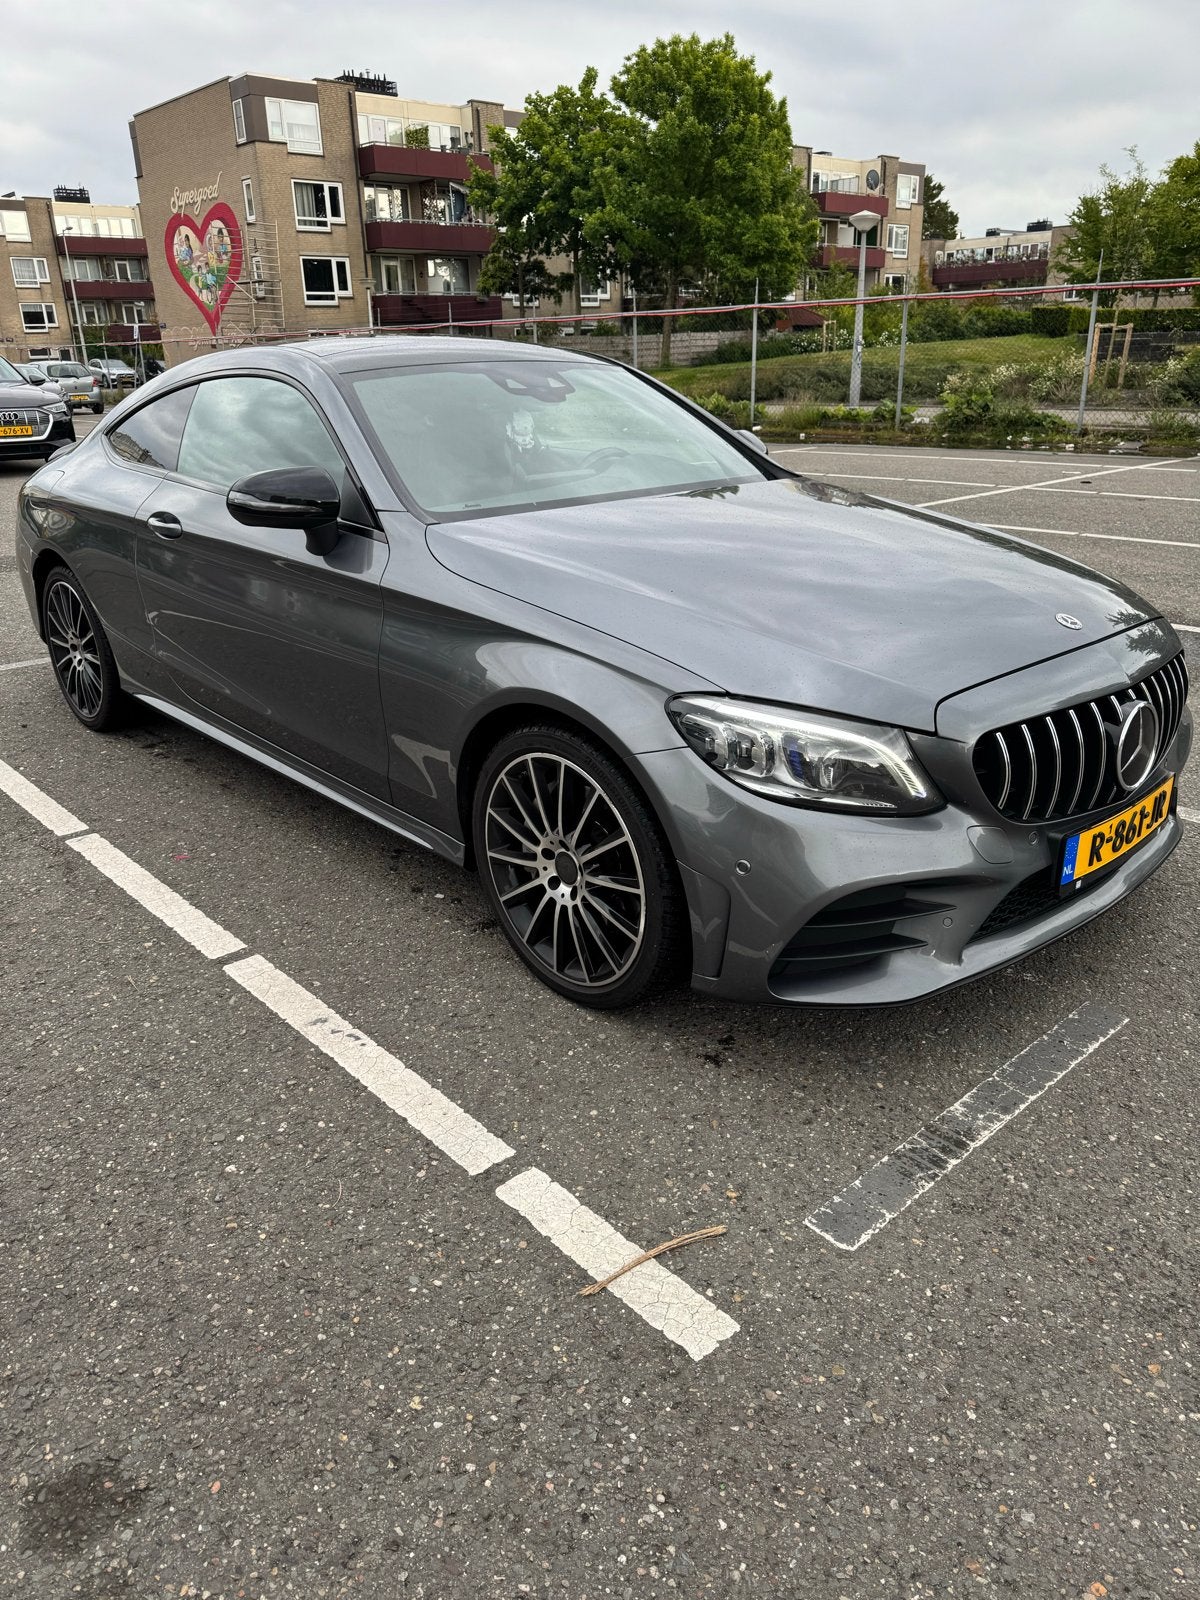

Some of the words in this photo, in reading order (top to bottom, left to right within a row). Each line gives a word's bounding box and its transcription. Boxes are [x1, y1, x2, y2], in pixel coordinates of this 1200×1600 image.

[171, 171, 222, 217] Supergoed
[1088, 790, 1167, 867] R-861-JR
[1063, 865, 1073, 876] NL
